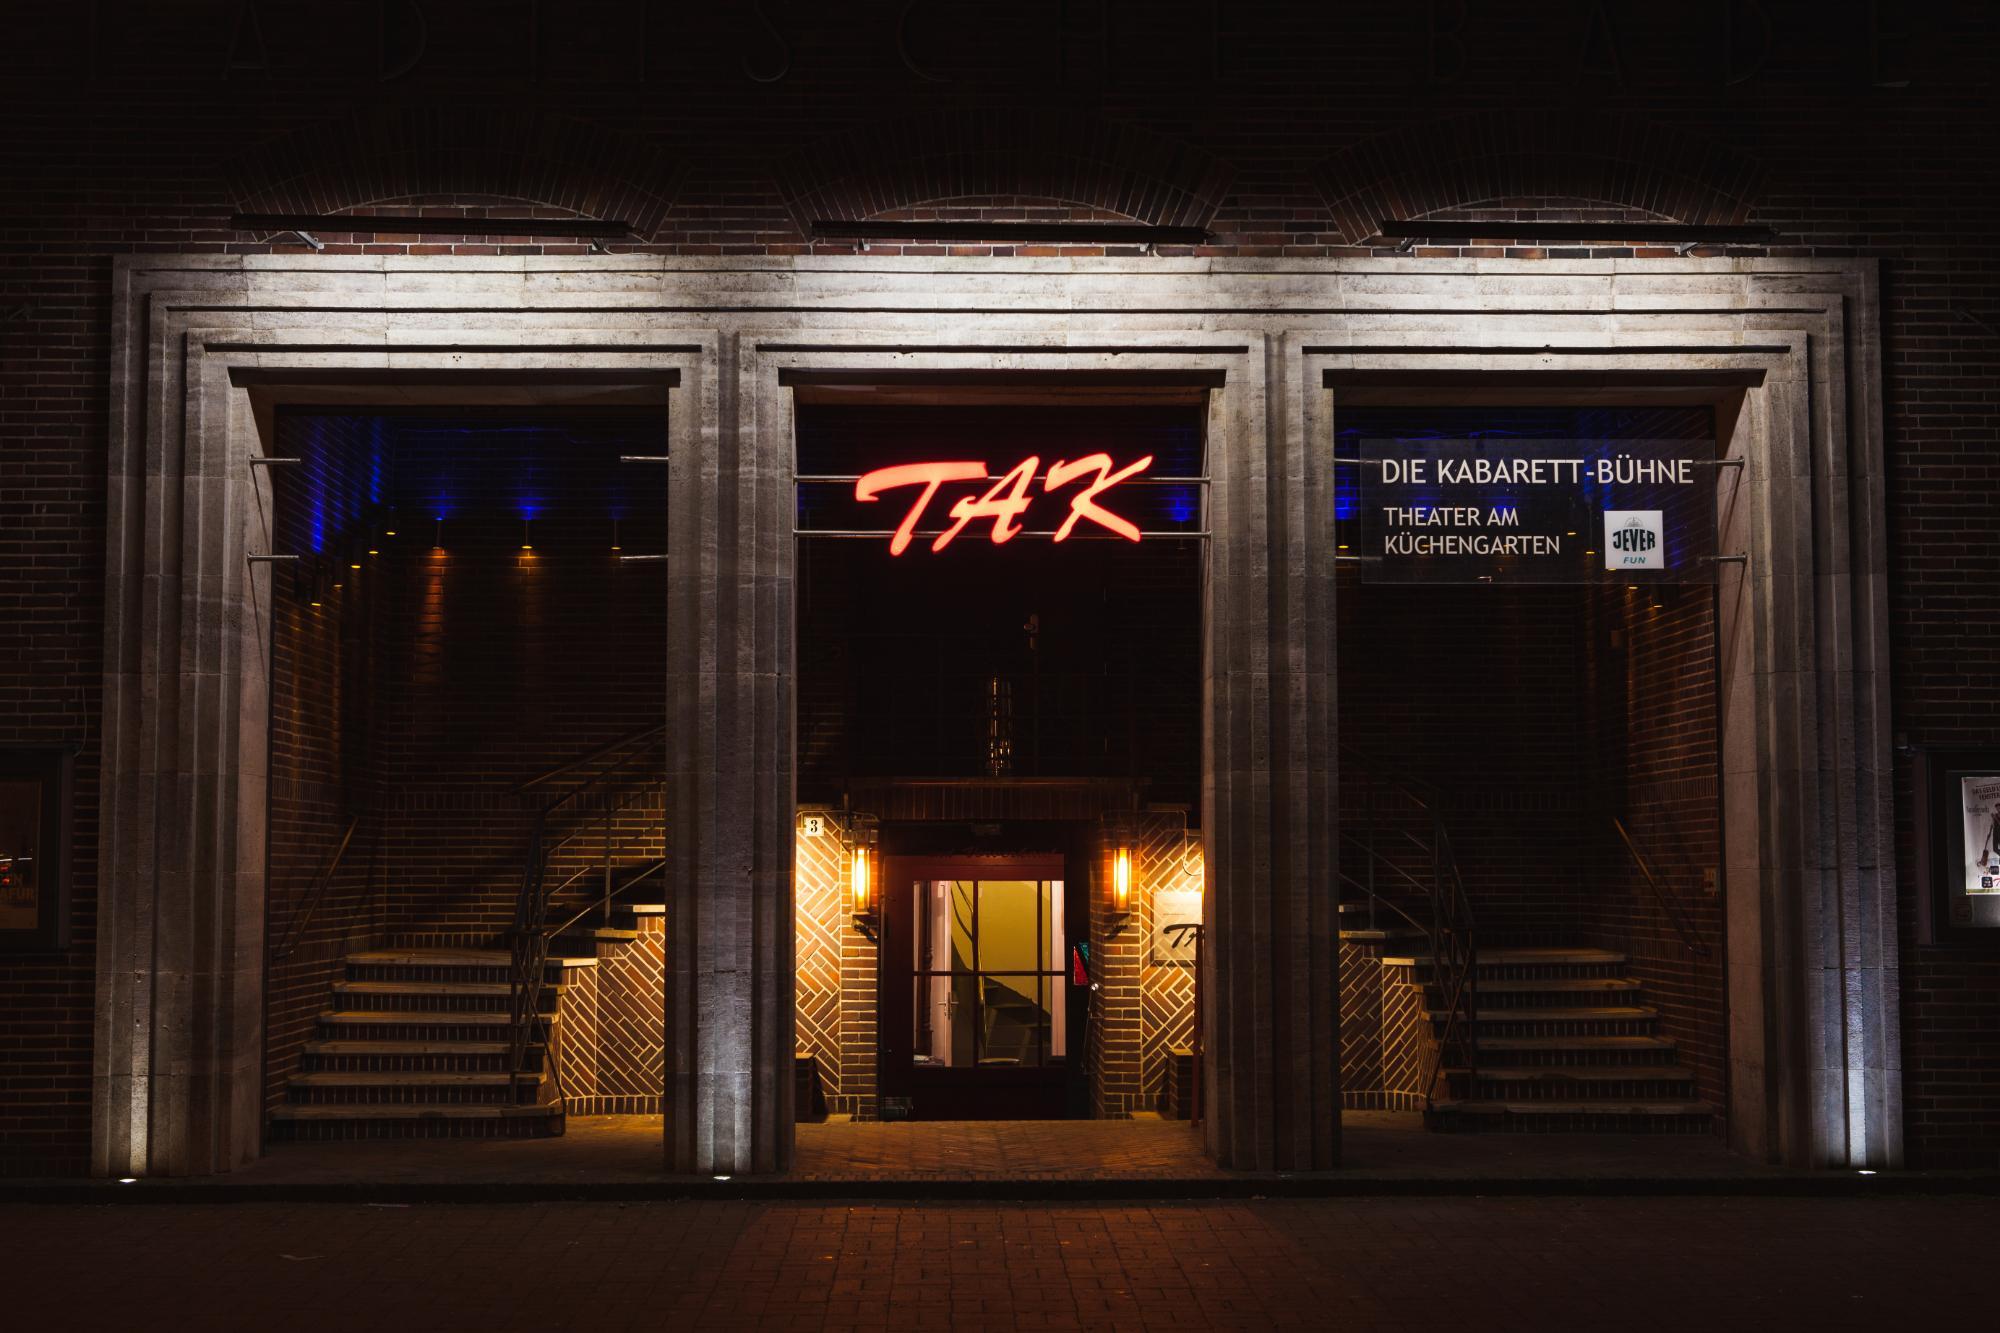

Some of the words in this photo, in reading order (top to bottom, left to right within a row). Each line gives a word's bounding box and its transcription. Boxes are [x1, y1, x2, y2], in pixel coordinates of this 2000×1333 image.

[1382, 458, 1427, 484] DIE
[1437, 453, 1694, 484] KABARETT-BÜHNE
[855, 453, 1154, 556] TAK
[1383, 507, 1481, 527] THEATER
[1487, 507, 1519, 527] AM
[1385, 531, 1560, 555] KÜCHENGARTEN
[1612, 528, 1656, 552] JEVER
[1623, 556, 1646, 564] FUN
[810, 819, 818, 833] 3
